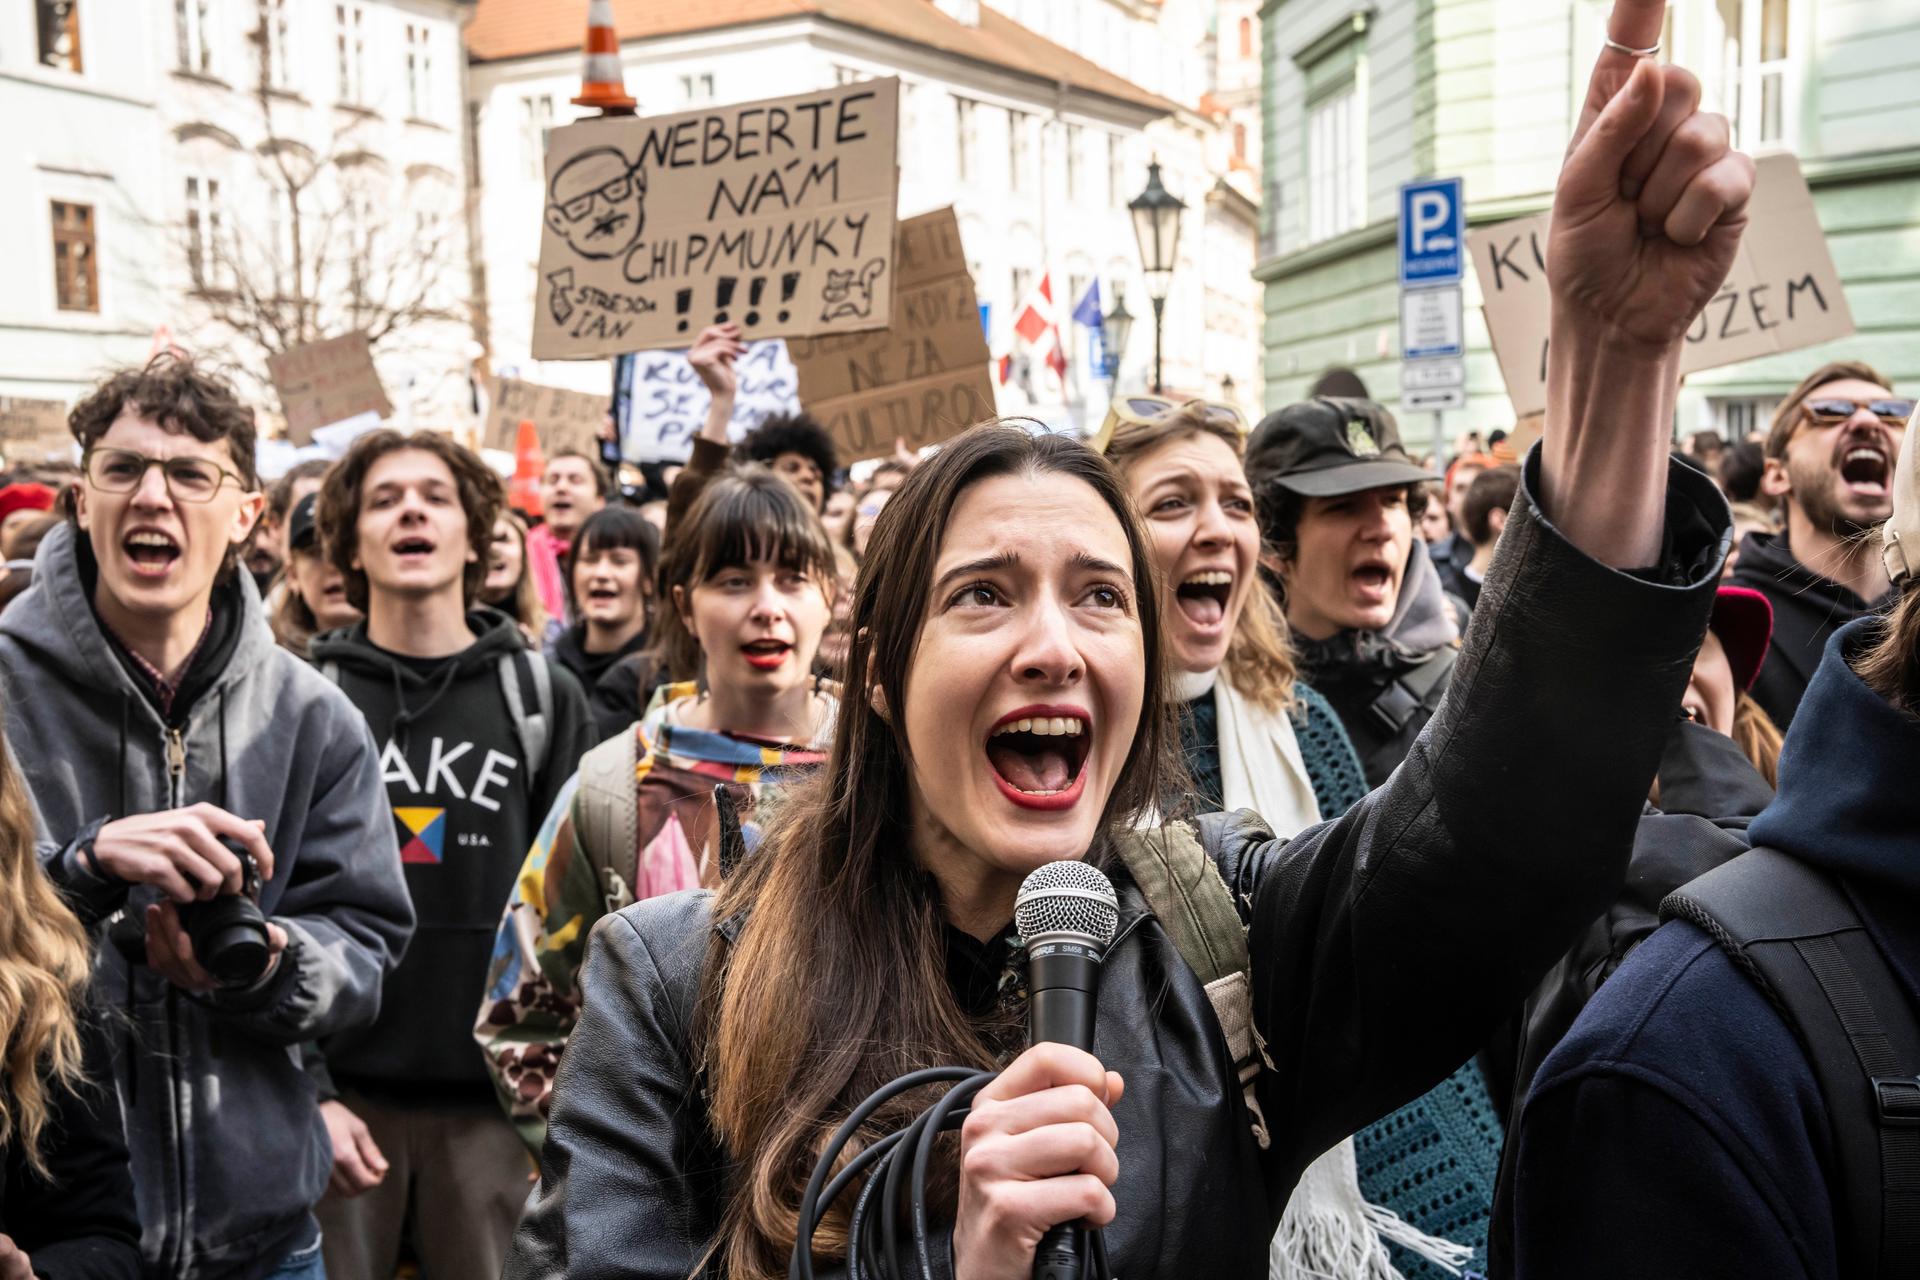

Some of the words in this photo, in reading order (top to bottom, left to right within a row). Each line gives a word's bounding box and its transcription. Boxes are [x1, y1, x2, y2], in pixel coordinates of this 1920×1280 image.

[634, 91, 876, 169] NEBERTE
[707, 157, 839, 221] NÁM
[623, 213, 869, 284] CHIPMUNKY
[1411, 190, 1450, 255] P
[570, 310, 634, 339] IAN
